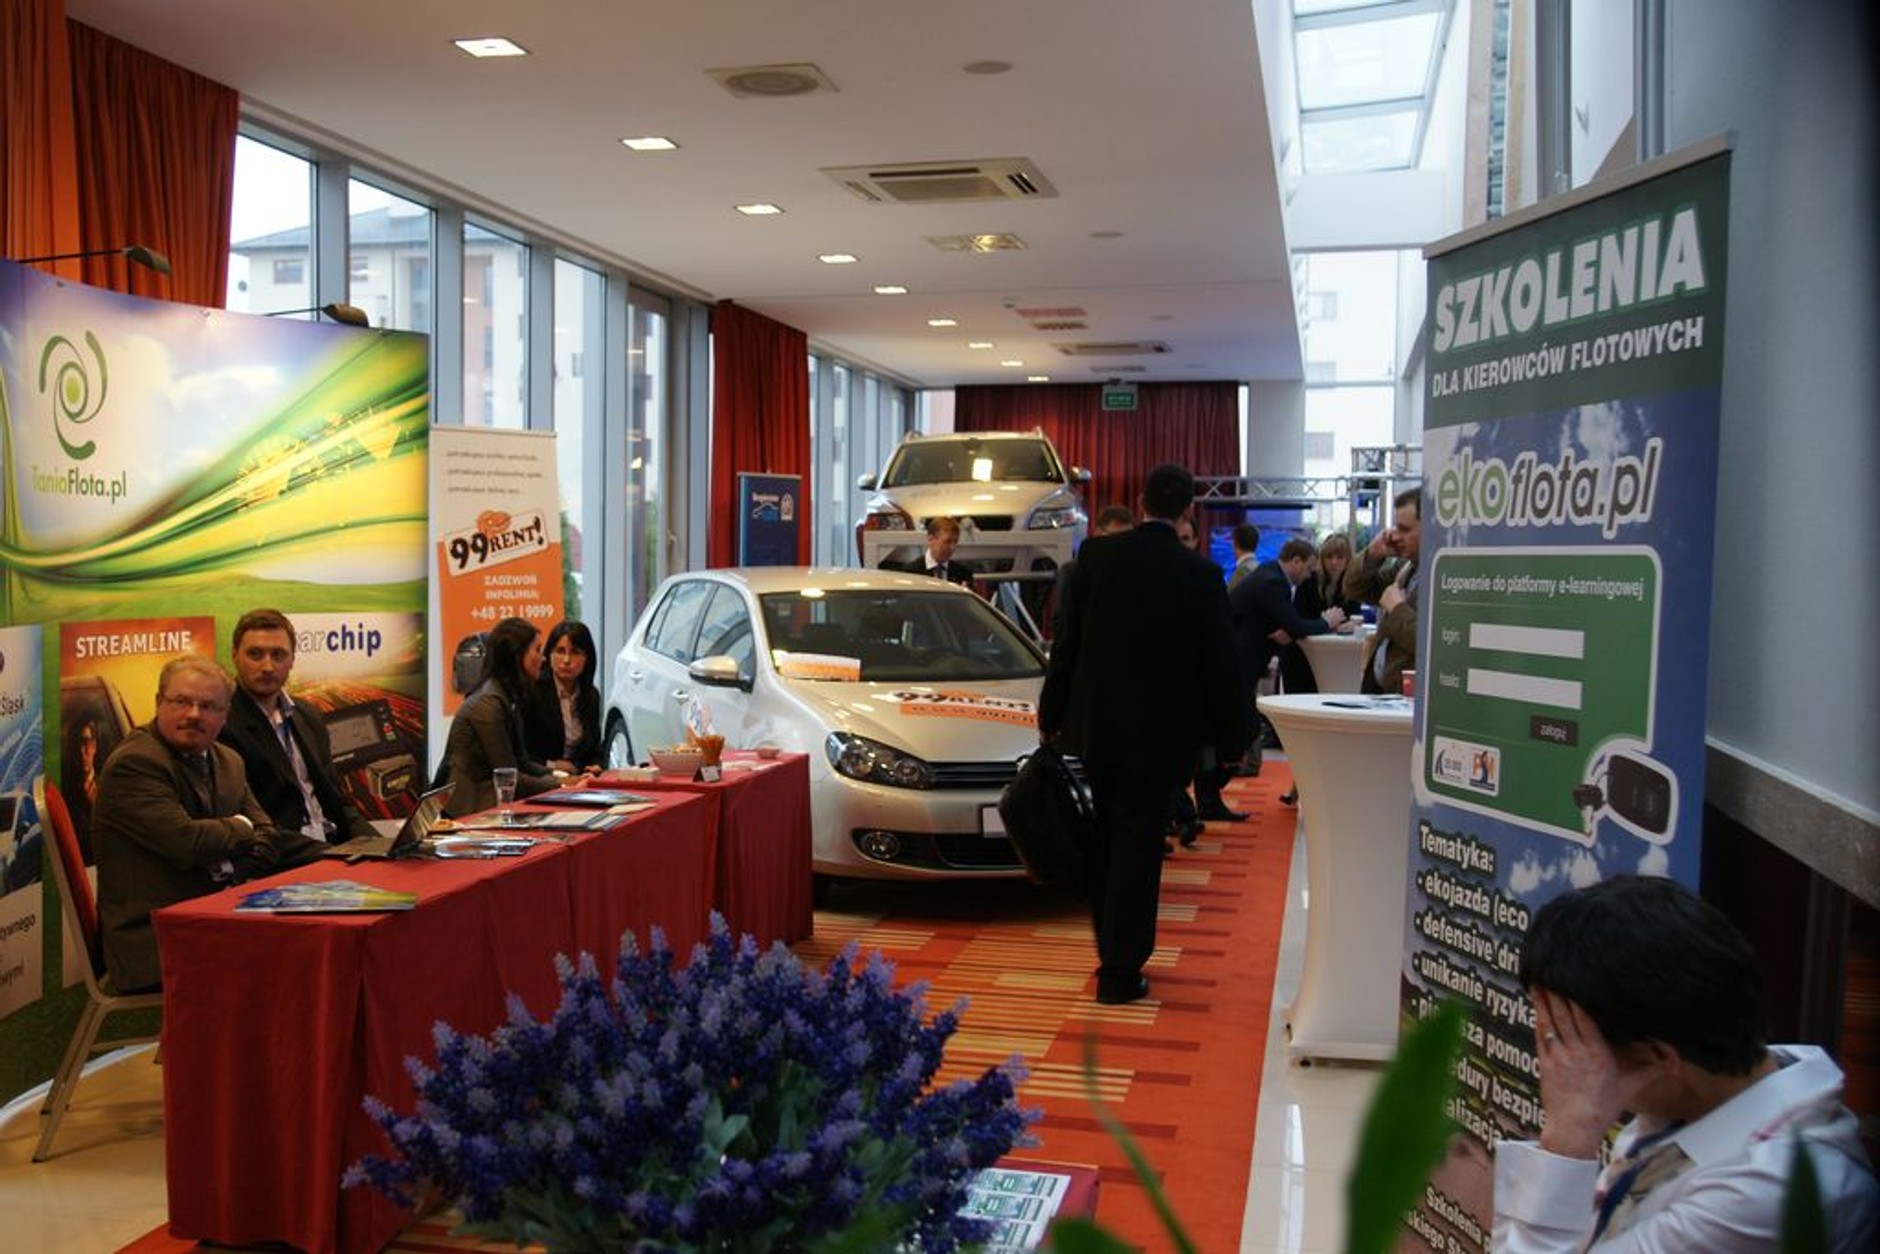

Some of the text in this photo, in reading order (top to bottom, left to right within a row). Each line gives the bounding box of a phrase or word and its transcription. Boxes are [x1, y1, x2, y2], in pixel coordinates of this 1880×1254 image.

[1433, 207, 1705, 352] SZKOLENIA
[1432, 317, 1704, 397] DLA KIEROWCÓW FLOTOWYCH
[30, 465, 126, 505] TaniaFlota.pl
[1437, 442, 1661, 534] ekoflota.pl
[1441, 573, 1645, 601] Logowanie do platformy e-learningowej
[76, 630, 193, 658] STREAMLINE
[1420, 825, 1494, 873] Tematyka:
[1425, 871, 1490, 915] ekojazda
[1423, 912, 1520, 974] defensive dri
[1421, 955, 1484, 1001] unikanie
[1426, 1186, 1482, 1246] Szkolenia
